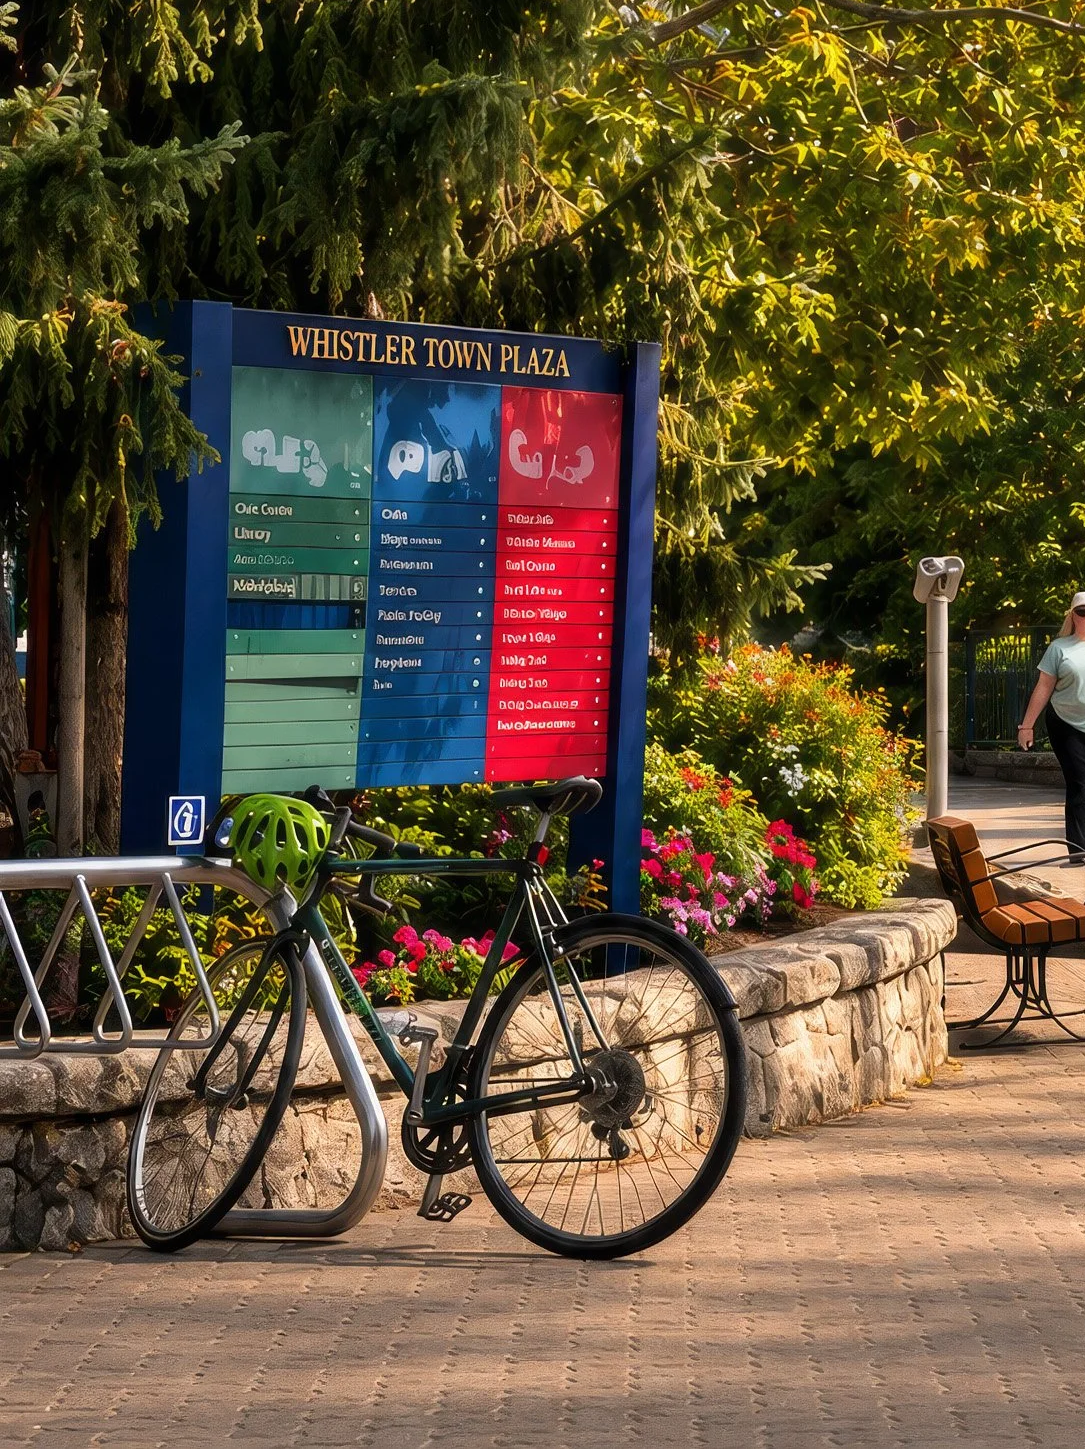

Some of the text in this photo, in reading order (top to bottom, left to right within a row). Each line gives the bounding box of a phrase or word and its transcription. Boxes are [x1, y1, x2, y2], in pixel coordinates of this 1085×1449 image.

[287, 326, 570, 377] WHISTLER TOWN PLAZA
